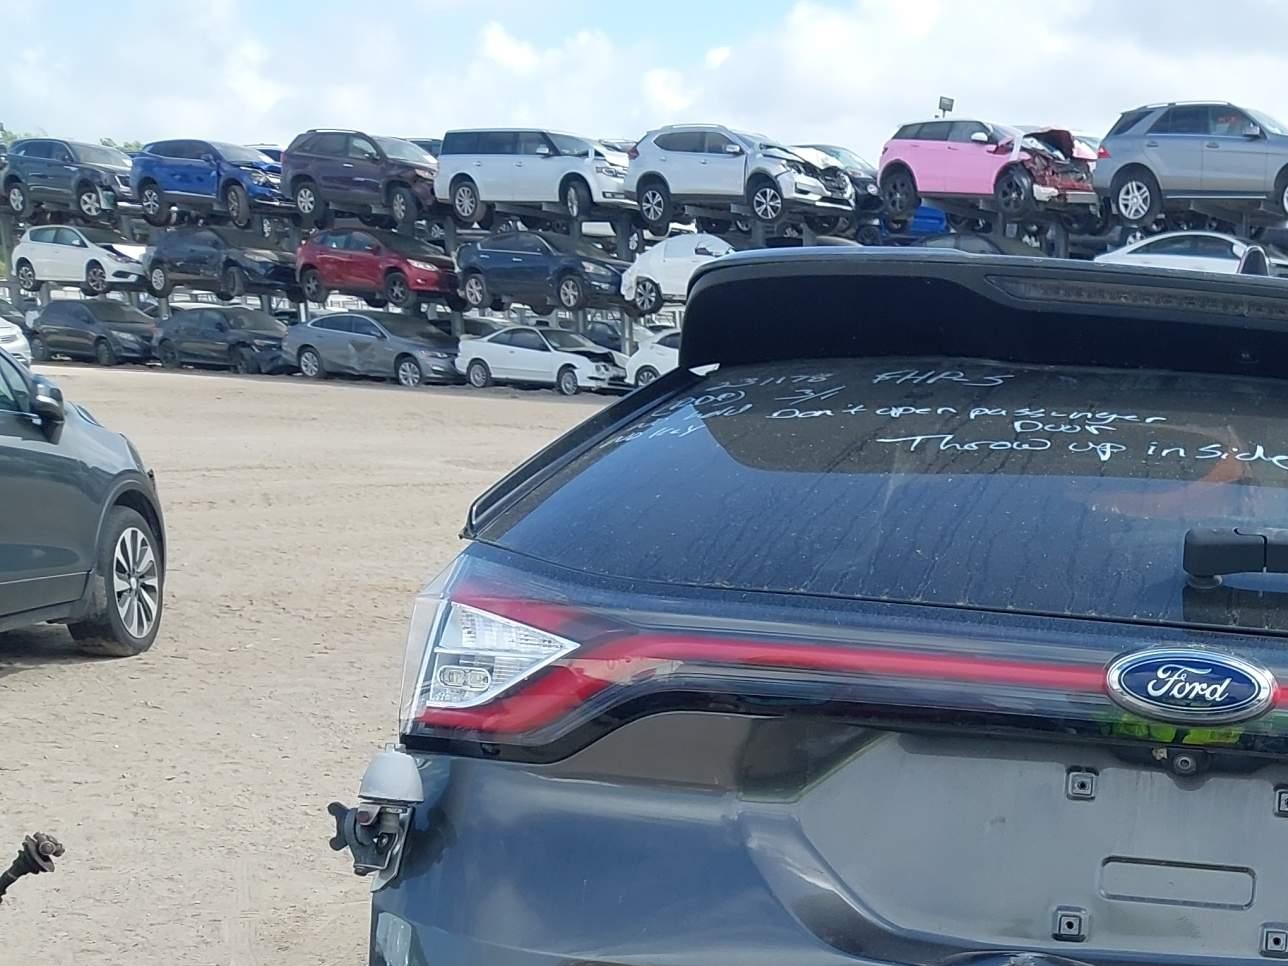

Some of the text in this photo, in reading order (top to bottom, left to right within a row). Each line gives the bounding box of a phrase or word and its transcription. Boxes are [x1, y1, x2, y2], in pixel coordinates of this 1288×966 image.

[875, 406, 957, 418] open
[1068, 441, 1127, 461] up
[1147, 663, 1233, 702] Ford
